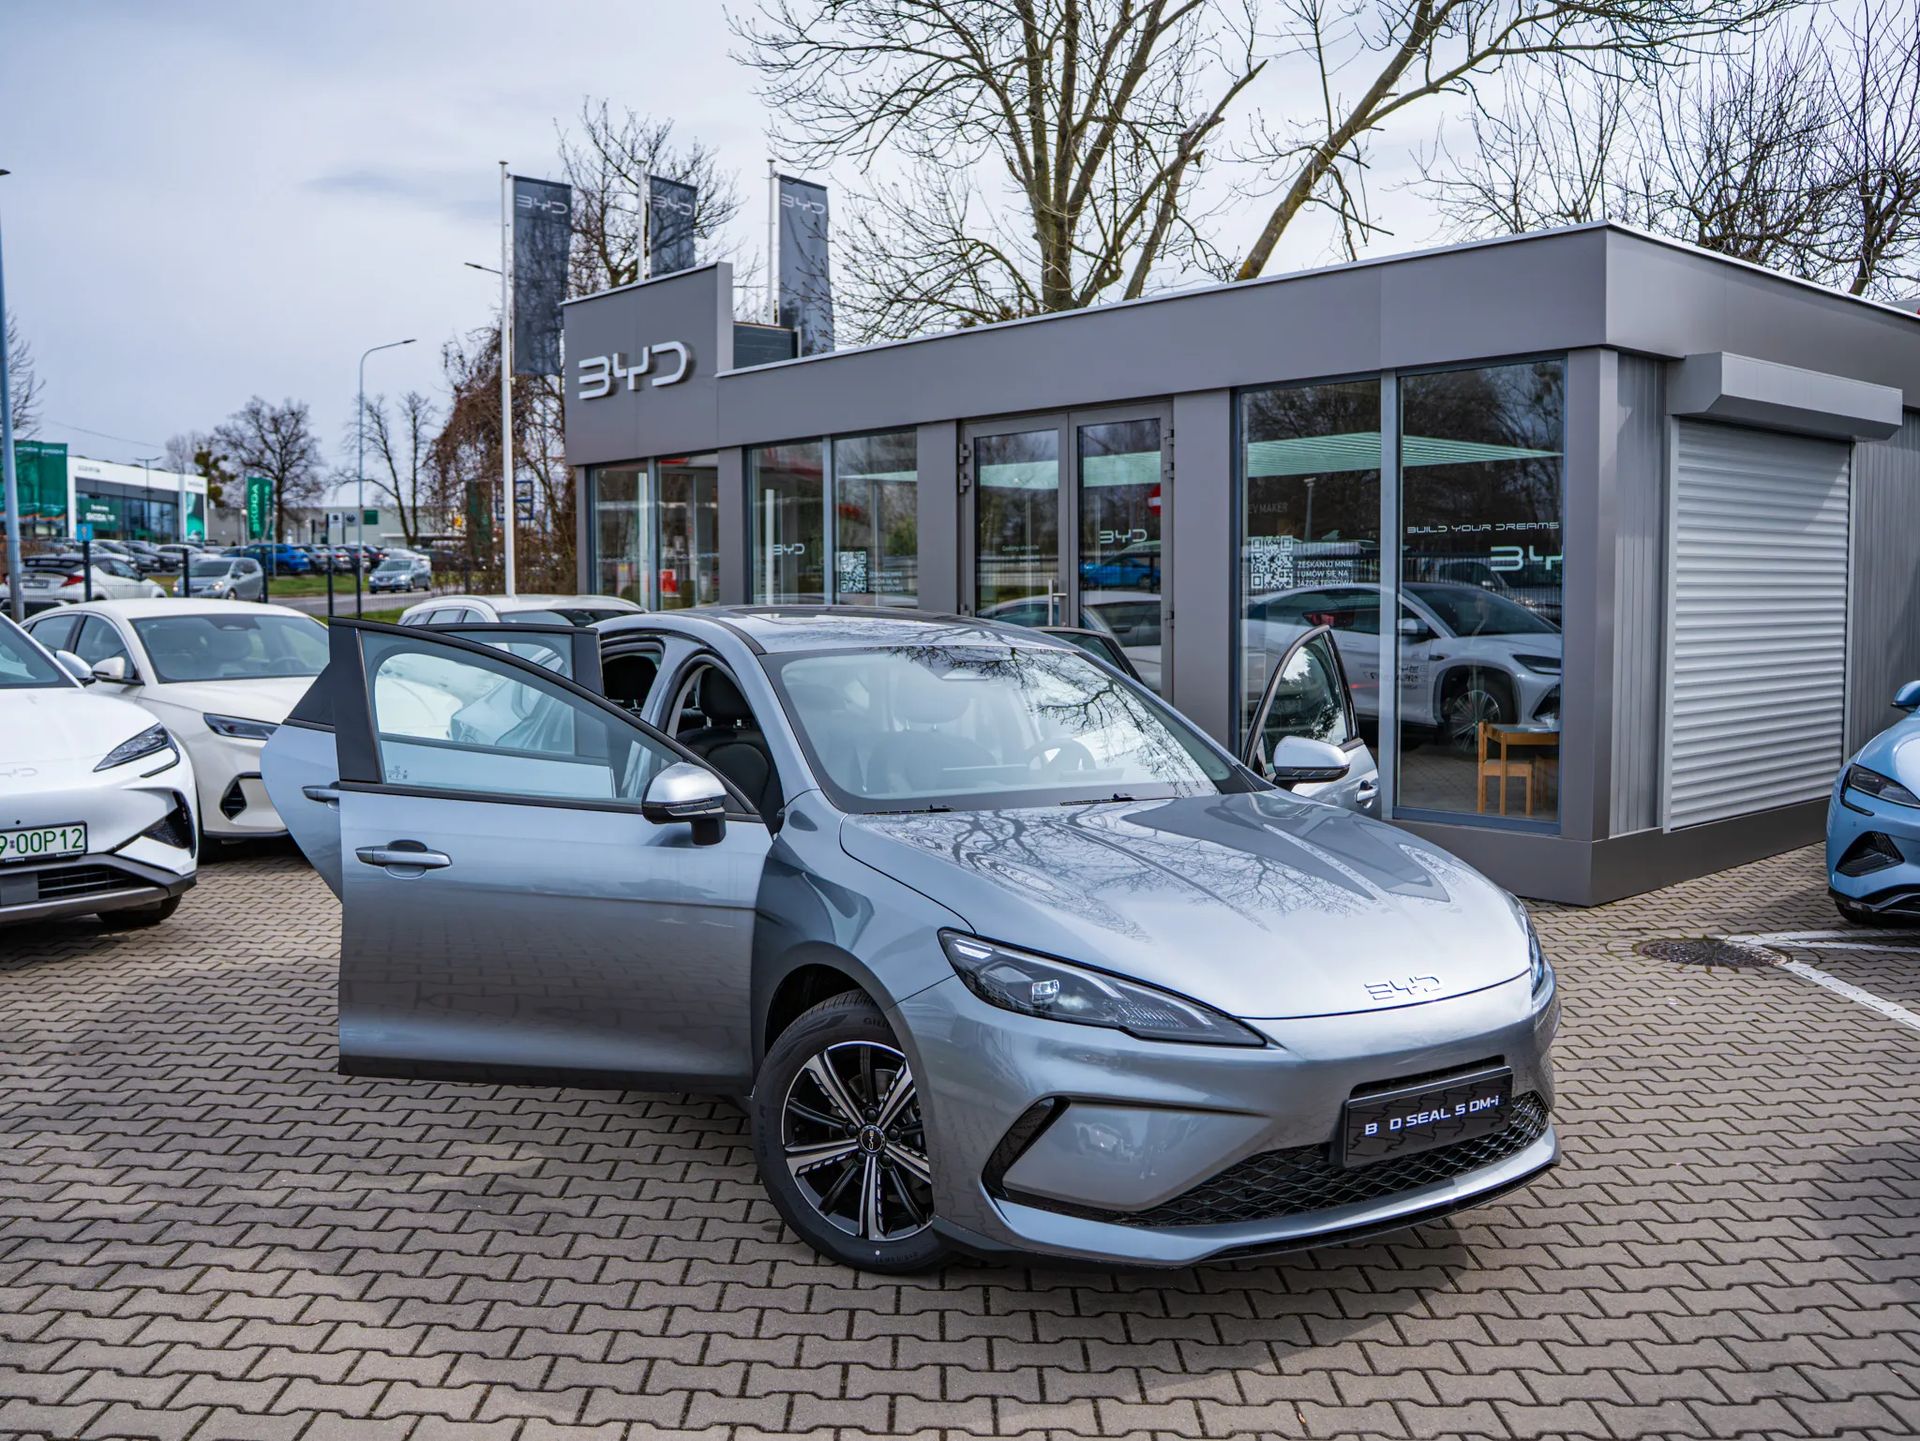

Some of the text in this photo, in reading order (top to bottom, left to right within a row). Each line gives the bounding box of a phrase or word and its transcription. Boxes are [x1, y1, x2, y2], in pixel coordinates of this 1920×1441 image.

[515, 194, 569, 215] BYD
[651, 195, 694, 216] BYD
[780, 193, 826, 215] BYD
[578, 340, 691, 400] BYD
[1100, 529, 1148, 544] BYD
[1407, 522, 1560, 534] BUILD YOUR DREAMS
[772, 543, 805, 556] BYD
[1490, 545, 1563, 571] BY
[1296, 560, 1353, 569] ZESKANUJ MNIE
[1363, 975, 1442, 1001] BYD
[1405, 1107, 1451, 1128] SEAL
[1468, 1094, 1500, 1113] DM-i
